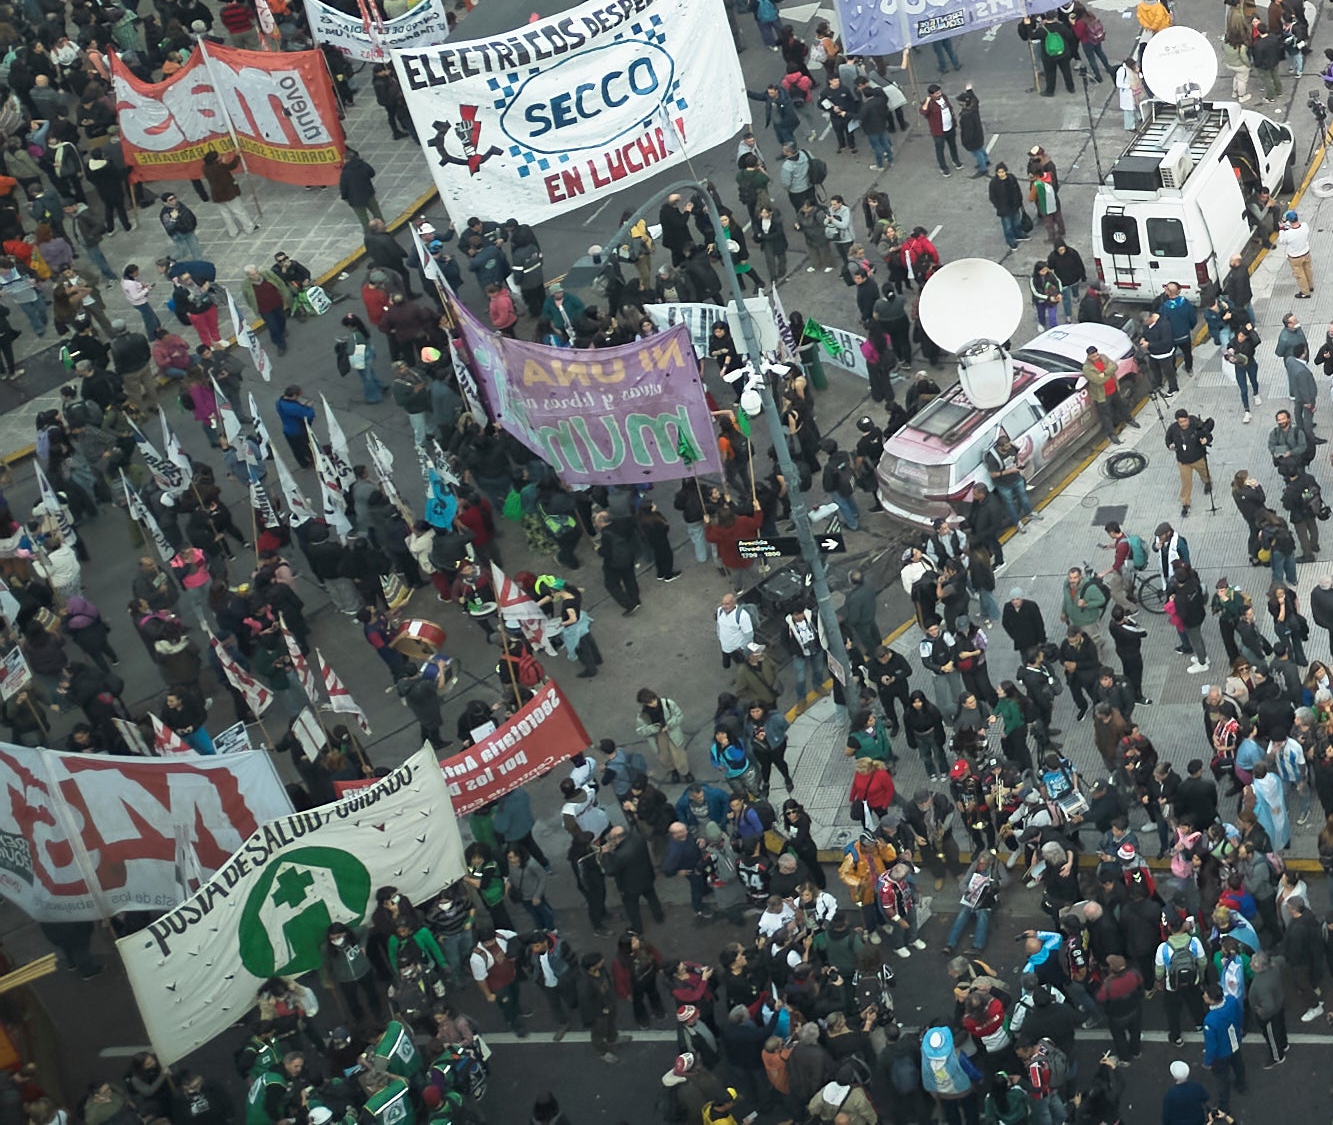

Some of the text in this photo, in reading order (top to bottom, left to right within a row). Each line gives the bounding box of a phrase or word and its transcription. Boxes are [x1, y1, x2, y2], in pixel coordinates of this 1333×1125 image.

[400, 16, 587, 91] ELECTRICOS
[525, 57, 660, 138] SECCO
[544, 166, 585, 205] EN
[220, 854, 253, 889] DE
[248, 810, 323, 867] SALUD
